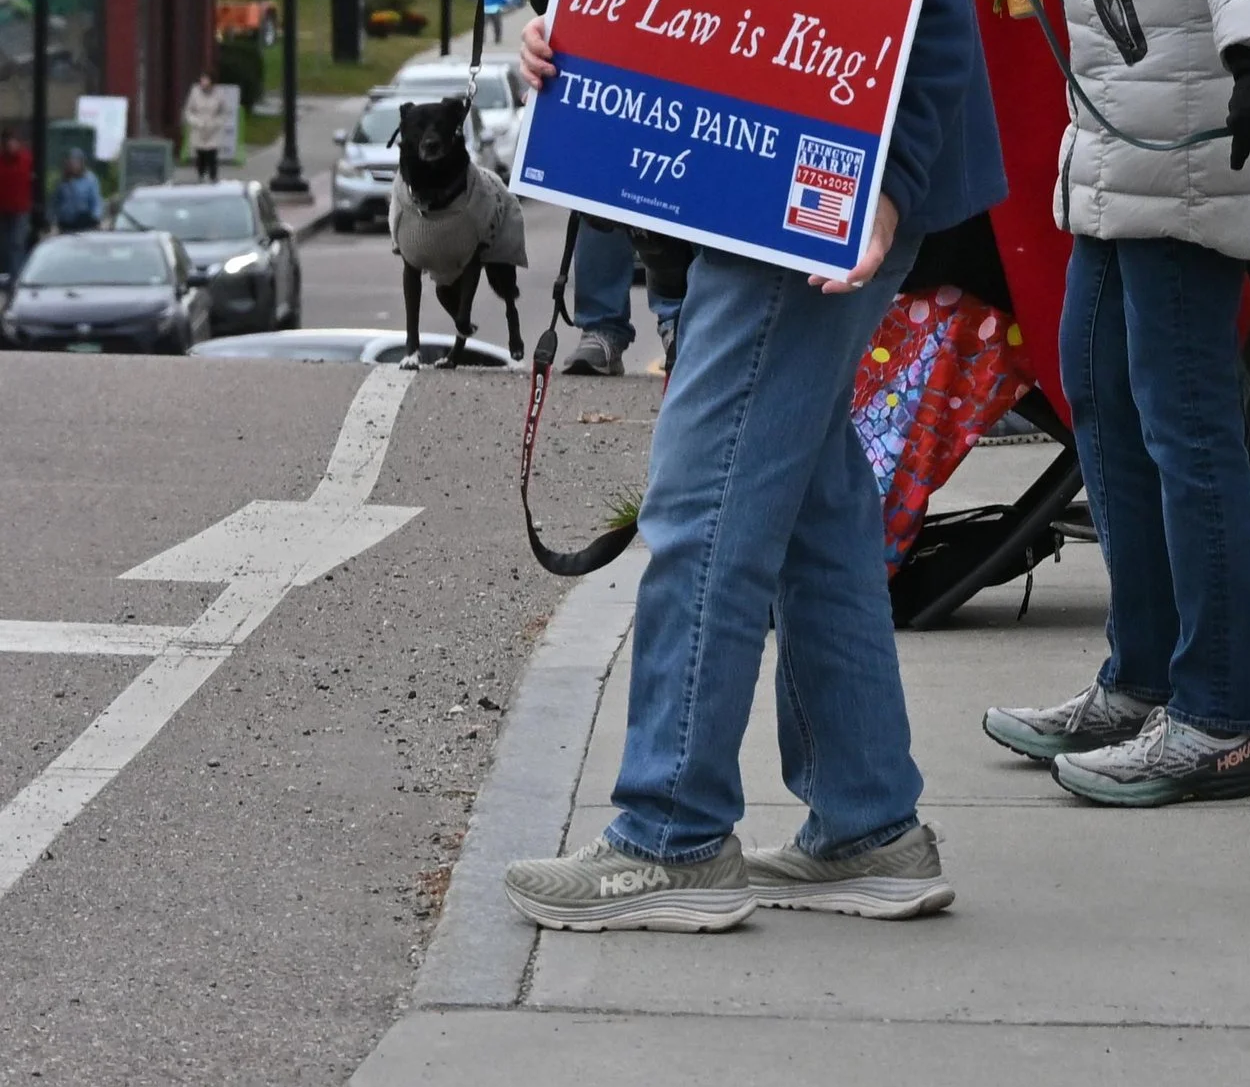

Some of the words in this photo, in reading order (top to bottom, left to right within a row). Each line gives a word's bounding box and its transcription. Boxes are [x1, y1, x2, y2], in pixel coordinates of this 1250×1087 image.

[729, 10, 765, 57] is
[772, 12, 893, 106] King!
[558, 69, 684, 133] THOMAS
[691, 107, 780, 160] PAINE
[629, 147, 692, 184] 1776
[800, 140, 862, 164] LEXINGTON
[600, 865, 670, 898] HOKA
